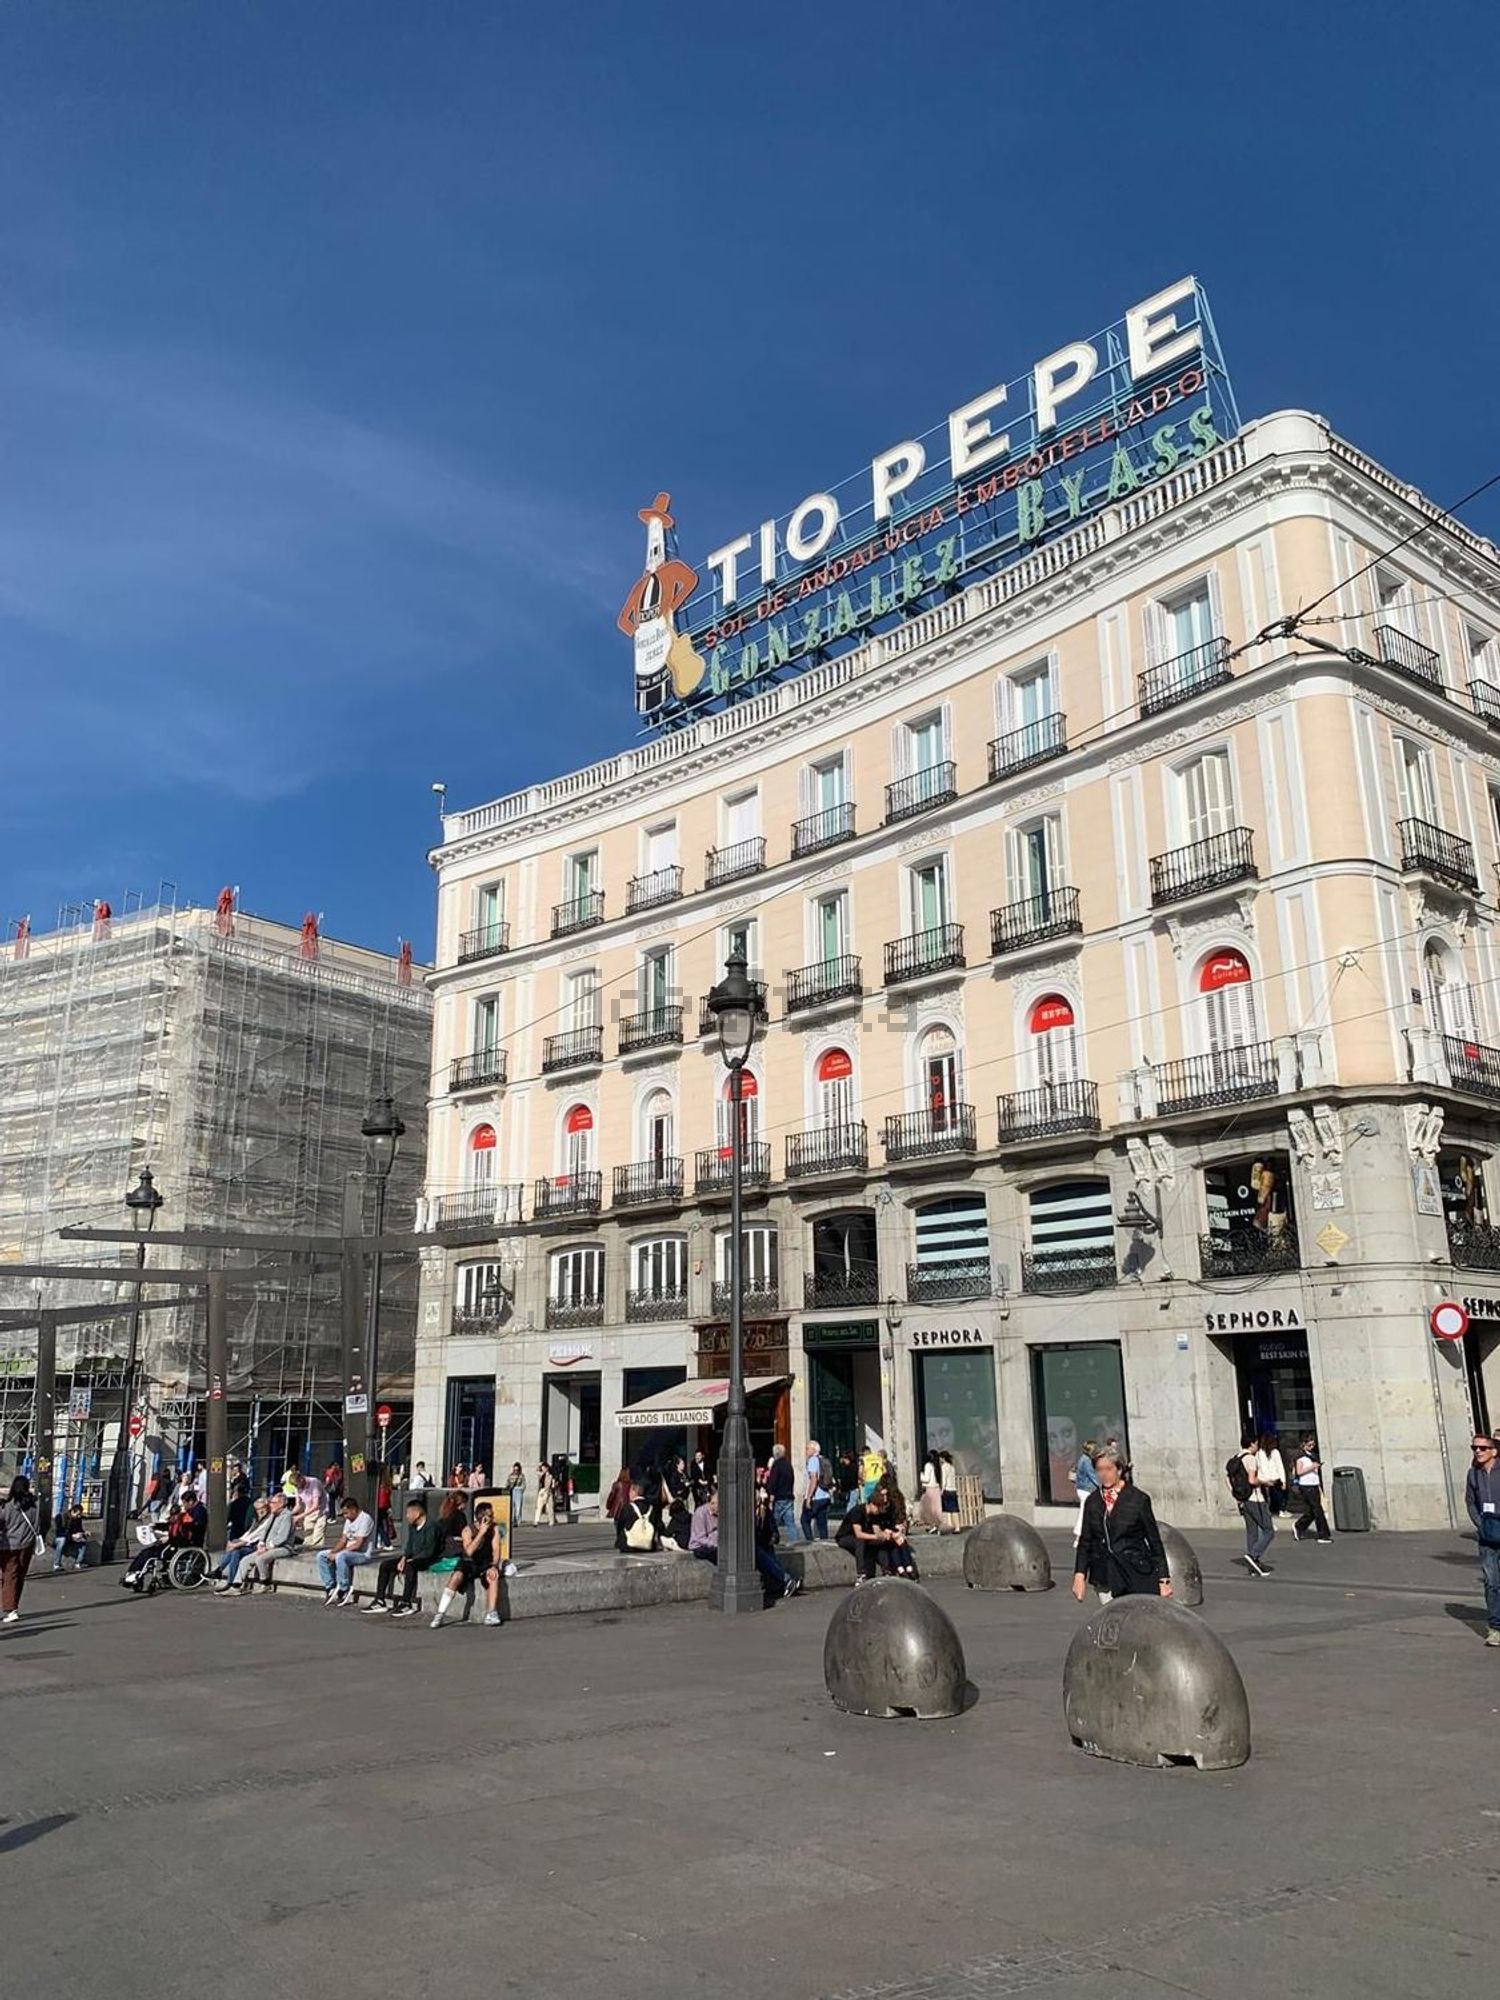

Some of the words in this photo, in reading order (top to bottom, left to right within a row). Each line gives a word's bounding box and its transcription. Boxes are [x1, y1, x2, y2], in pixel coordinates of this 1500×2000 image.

[708, 492, 839, 607] TIO
[872, 275, 1201, 521] PEPE
[704, 614, 749, 648] SOL
[757, 588, 788, 620] DE
[799, 506, 946, 597] ANDALUCIA
[953, 370, 1202, 514] EMBOTELLADO
[711, 534, 959, 696] GONZALEZ
[1016, 405, 1218, 544] BYASS
[1206, 1309, 1299, 1331] SEPHORA
[913, 1328, 983, 1346] SEPHORA
[618, 1414, 659, 1426] HELADOS
[661, 1412, 709, 1424] ITALIANOS
[871, 1463, 879, 1474] 7
